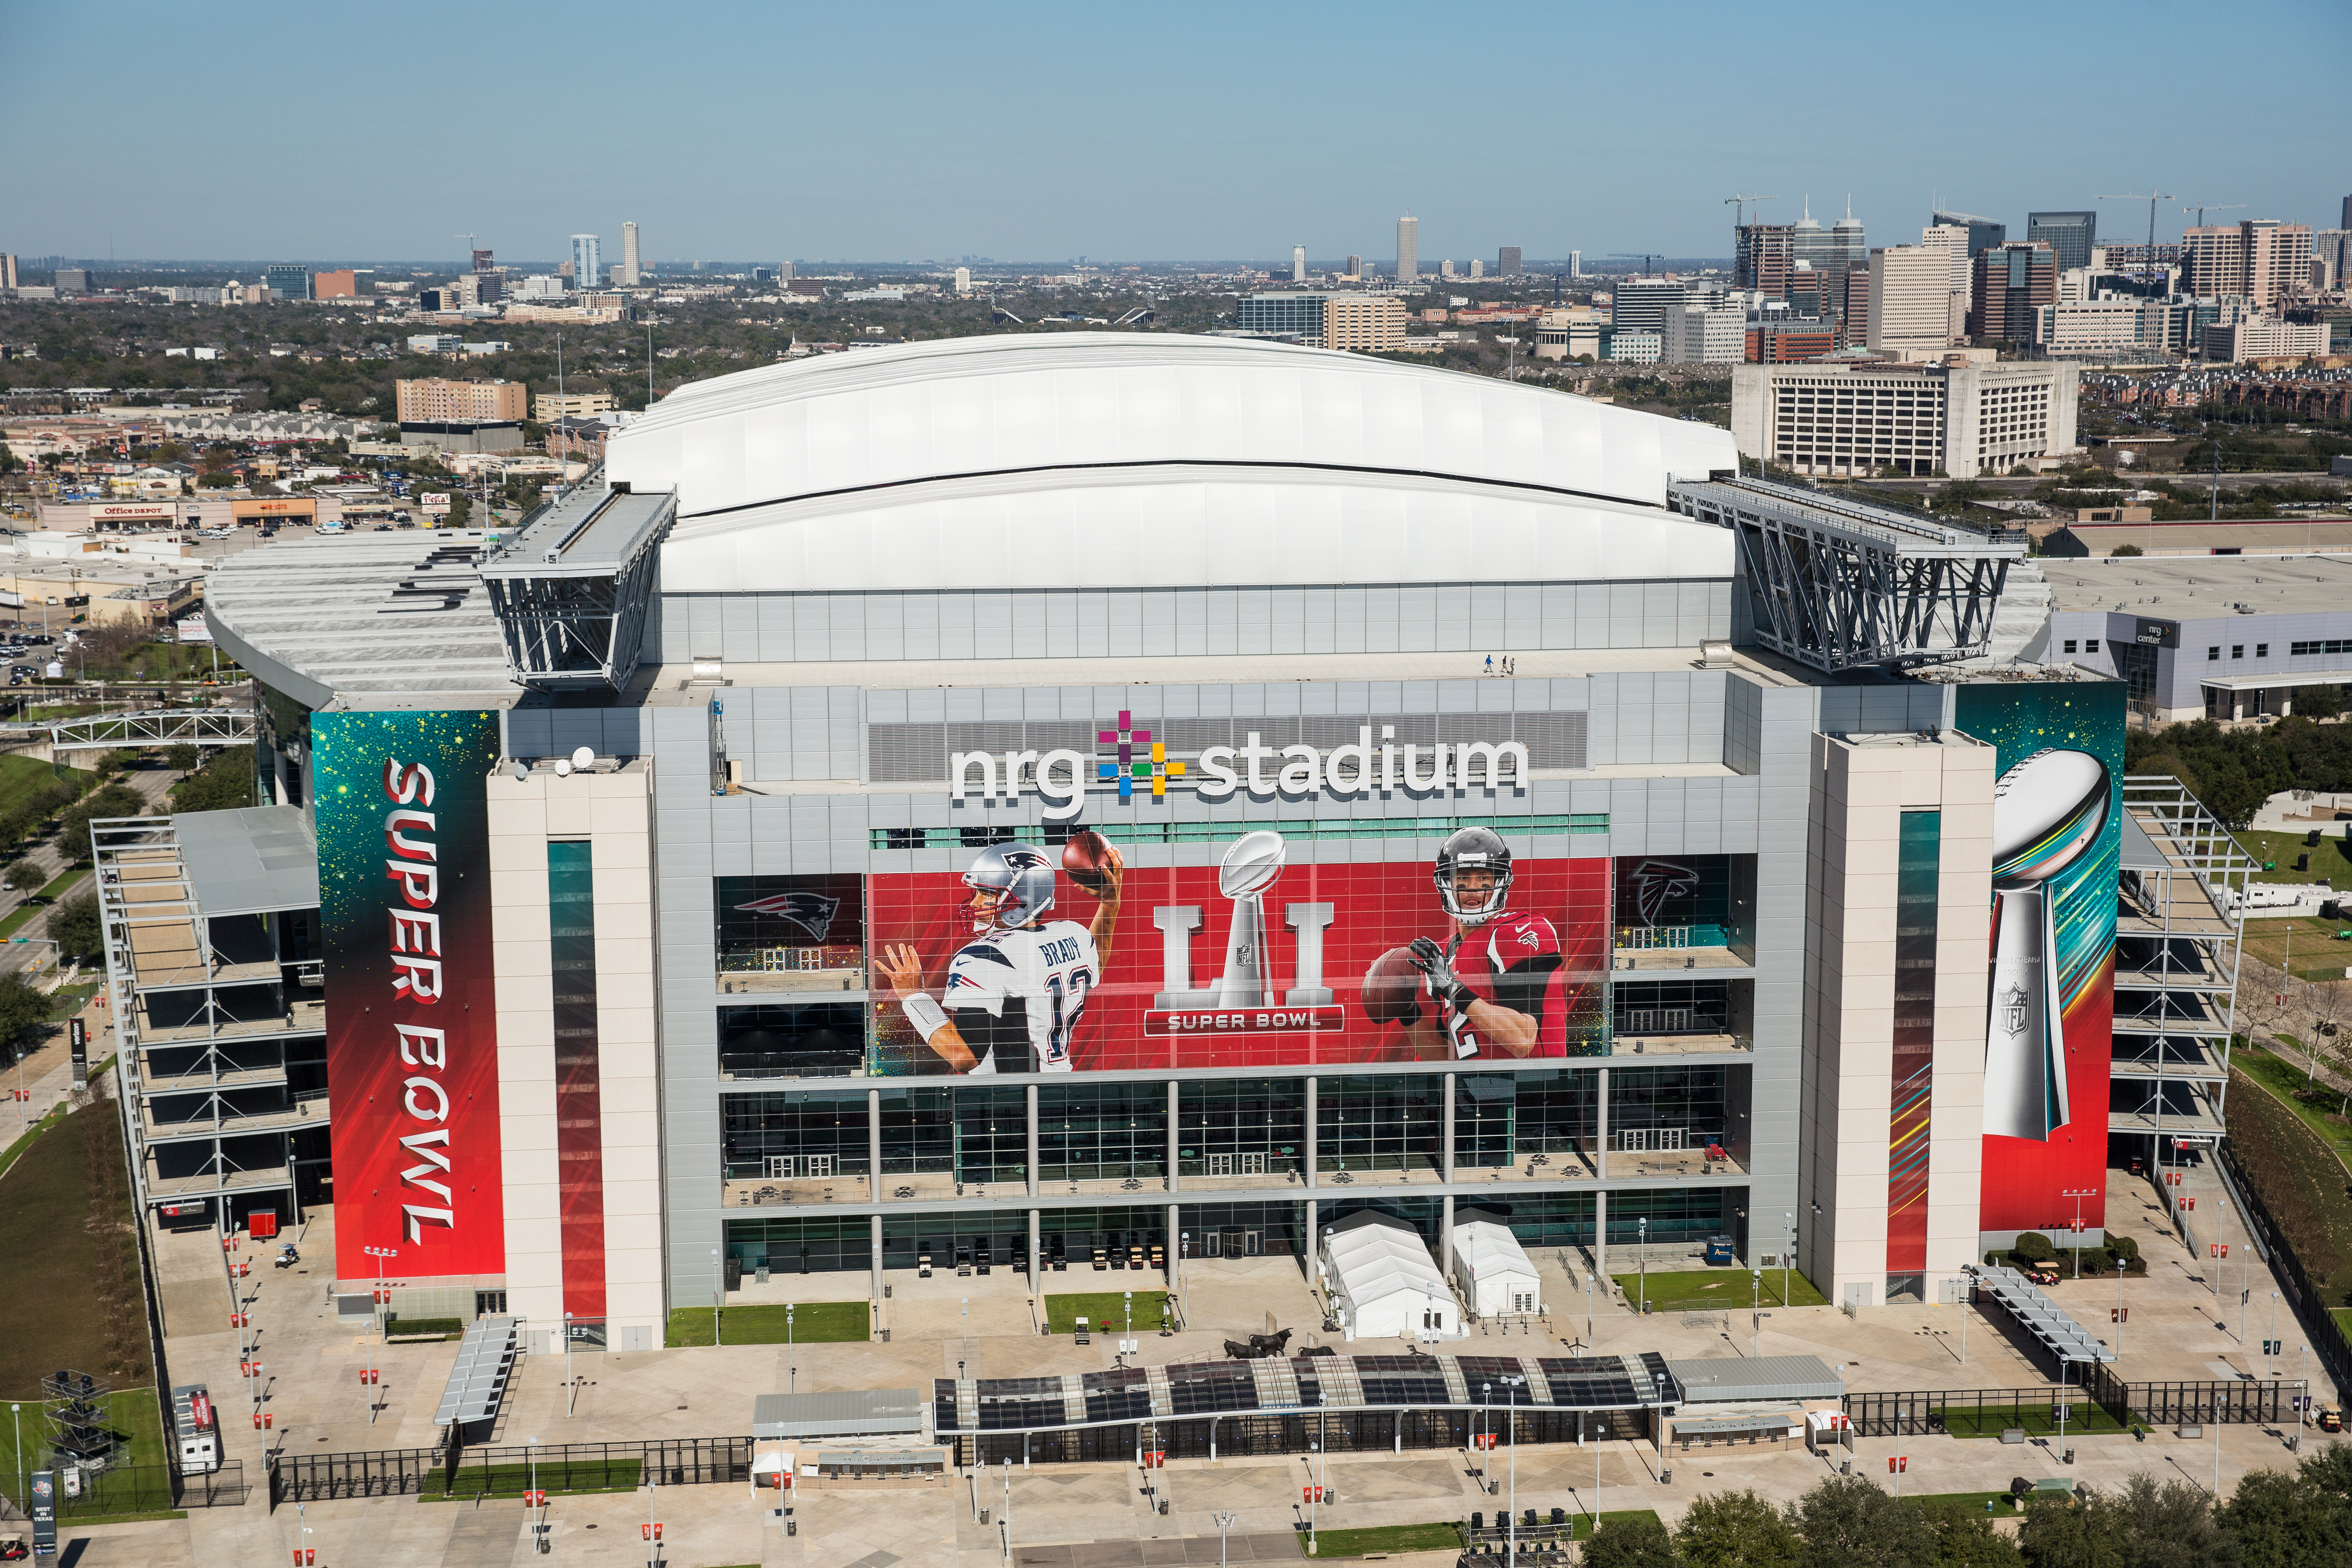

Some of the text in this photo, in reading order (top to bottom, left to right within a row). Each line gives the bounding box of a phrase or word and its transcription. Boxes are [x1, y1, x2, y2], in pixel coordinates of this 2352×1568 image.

[2137, 635, 2161, 644] center
[2149, 626, 2161, 636] nrg
[952, 725, 1529, 820] nrg stadium
[1038, 937, 1081, 967] BRADY
[1238, 953, 1249, 964] NFL
[382, 756, 454, 1247] SUPER BOWL
[1044, 965, 1093, 1063] 12
[1168, 1012, 1321, 1029] SUPER BOWL
[2000, 1007, 2024, 1030] NFL
[72, 1023, 80, 1045] verizon
